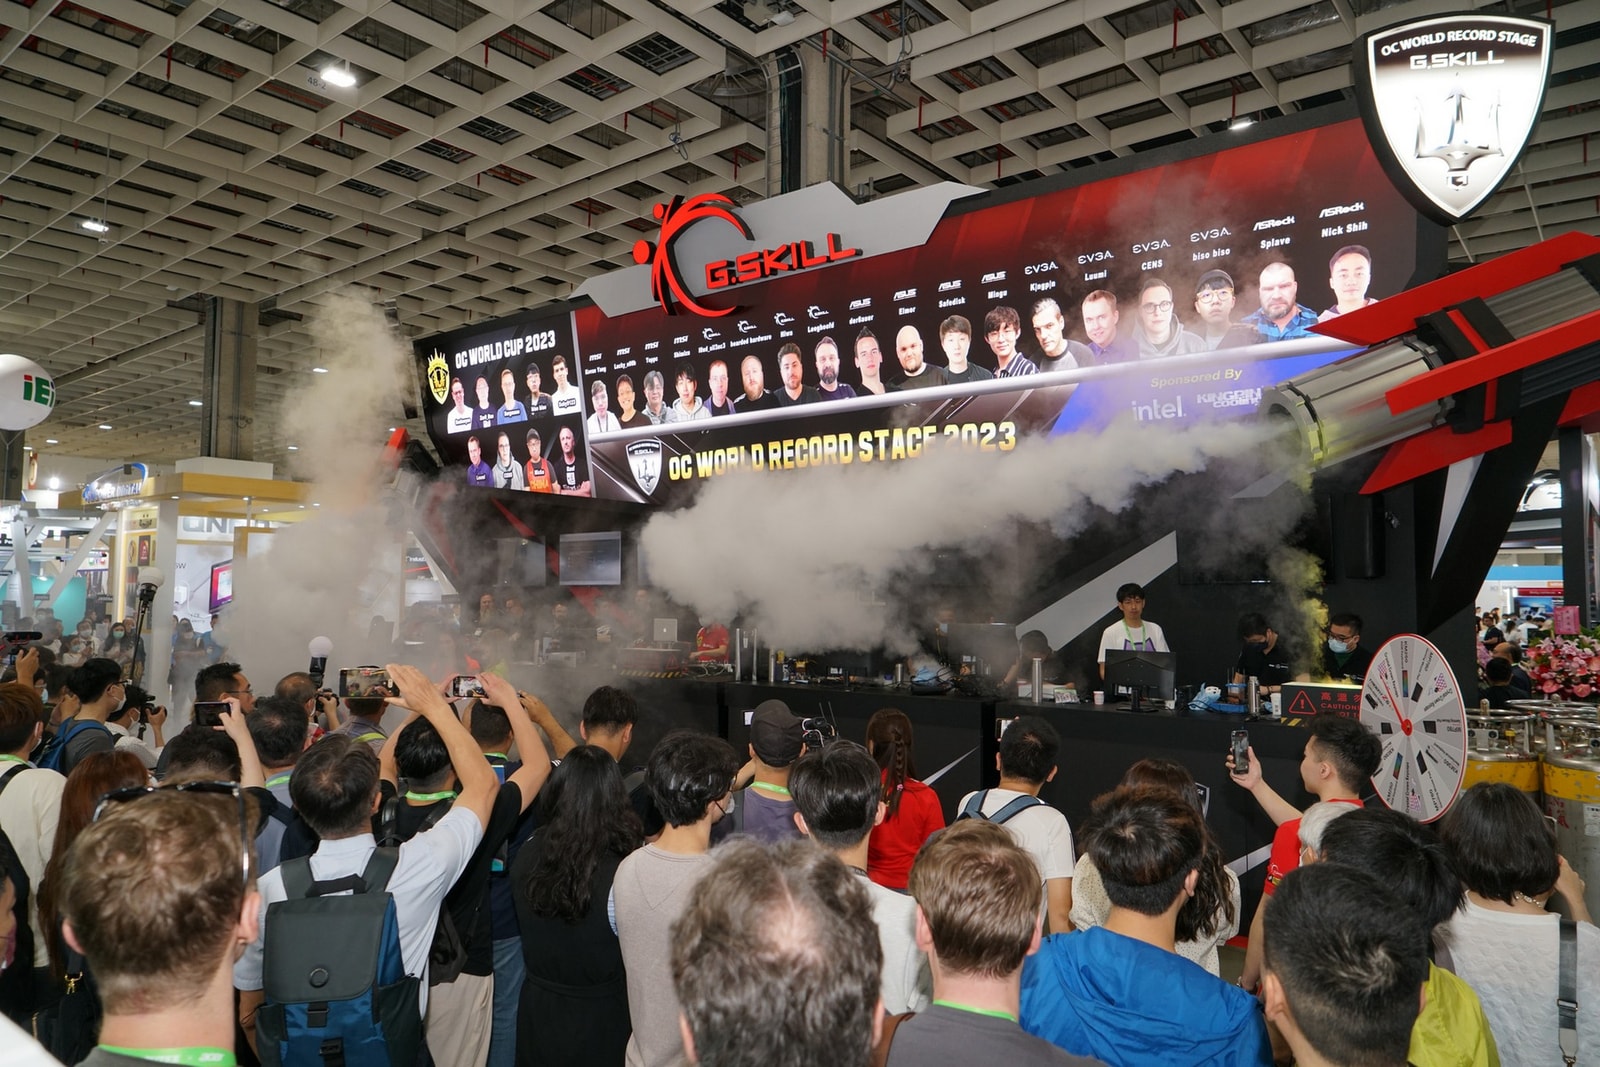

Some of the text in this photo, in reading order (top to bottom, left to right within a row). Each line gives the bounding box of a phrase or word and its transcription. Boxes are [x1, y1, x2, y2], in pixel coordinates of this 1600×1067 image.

[1381, 29, 1538, 56] OC WORLD RECORD STAGE
[1409, 50, 1505, 70] G.SKILL
[1190, 227, 1231, 243] EVGA
[1321, 221, 1368, 238] Nick Shih
[1132, 239, 1171, 254] EVGA
[1192, 247, 1231, 262] biso biso
[705, 232, 860, 289] G.SKILL
[1078, 250, 1114, 265] EVGA
[1024, 261, 1058, 275] EVGA
[455, 330, 556, 369] OC WORLD CUP 2023
[1151, 368, 1242, 389] Sponsored By
[669, 454, 693, 481] OC
[769, 433, 853, 471] RECORD
